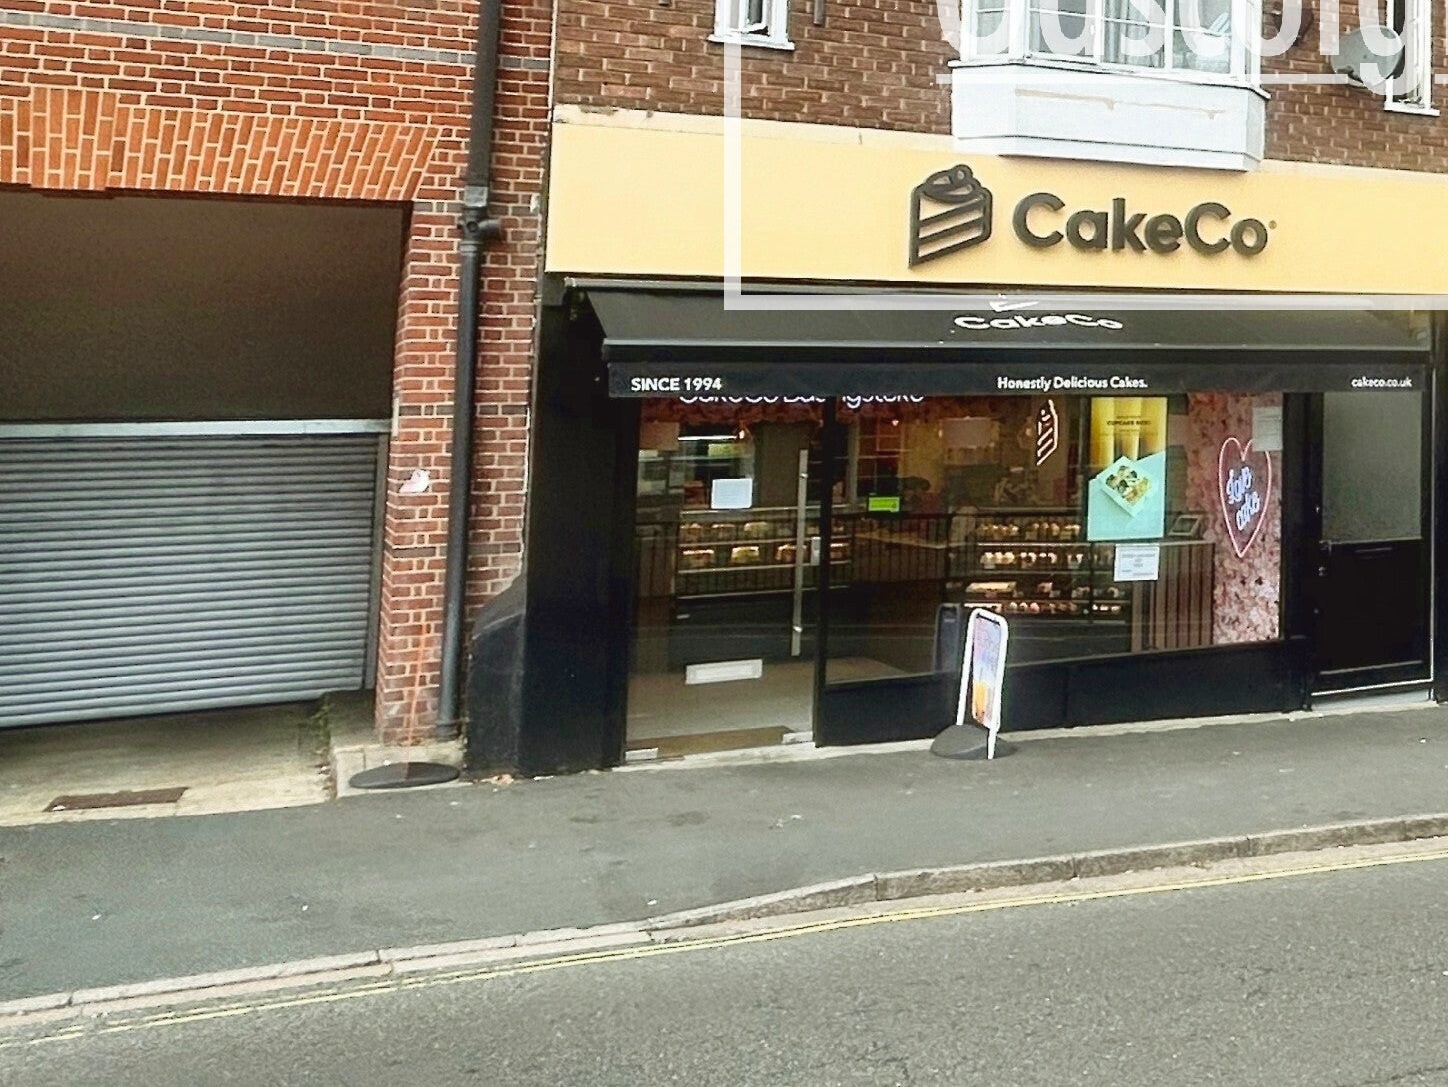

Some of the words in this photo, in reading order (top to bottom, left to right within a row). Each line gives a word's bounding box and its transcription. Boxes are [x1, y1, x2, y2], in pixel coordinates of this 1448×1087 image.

[1012, 192, 1268, 256] CakeCo
[953, 314, 1123, 330] CakeCo
[631, 378, 680, 391] SINCE
[684, 377, 722, 391] 1994
[997, 376, 1051, 392] Honestly
[1053, 376, 1108, 389] Delicious
[1110, 376, 1148, 388] Cakes.
[1351, 376, 1412, 388] cakeco.co.uk
